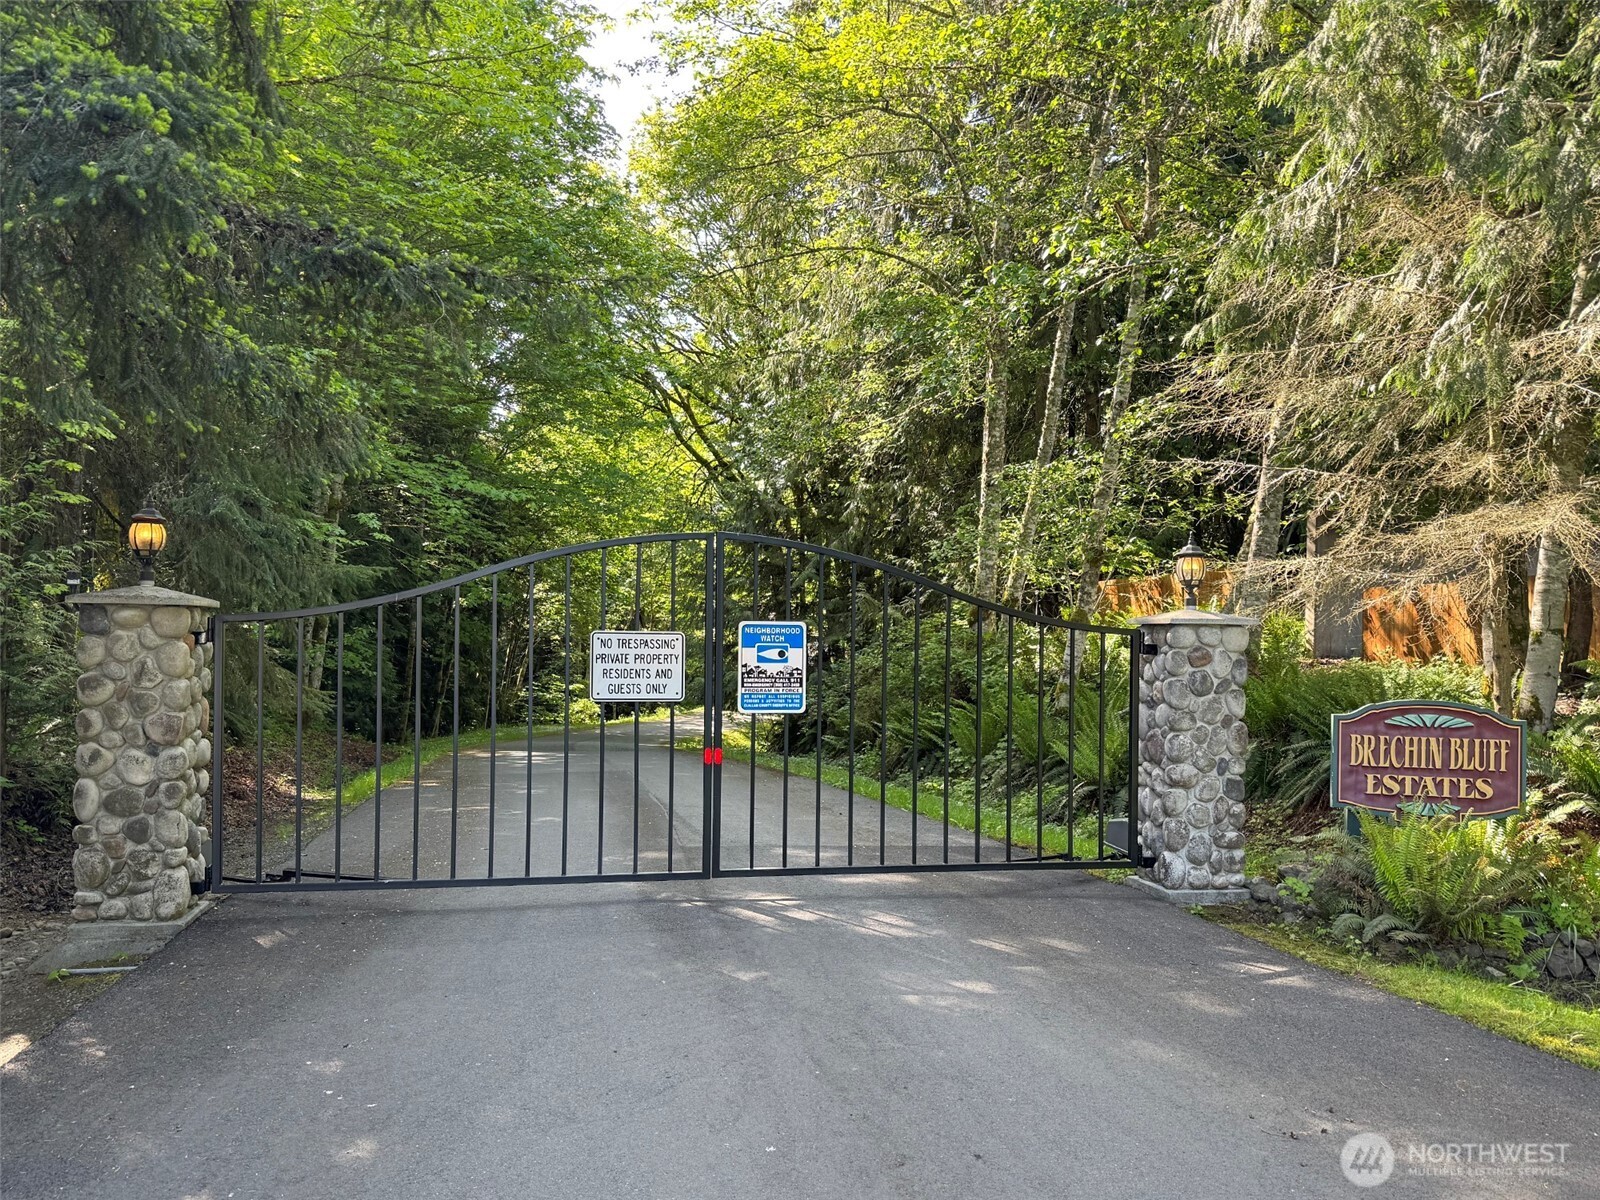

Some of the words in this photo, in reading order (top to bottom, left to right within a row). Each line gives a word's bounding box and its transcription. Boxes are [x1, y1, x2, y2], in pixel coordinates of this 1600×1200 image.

[600, 638, 612, 649] NO
[617, 638, 676, 650] TRESPASSING
[596, 654, 630, 664] PRIVATE
[634, 654, 680, 664] PROPERTY
[602, 668, 651, 680] RESIDENTS
[655, 668, 672, 680] AND
[608, 684, 642, 694] GUESTS
[646, 684, 668, 694] ONLY
[1349, 734, 1444, 770] BRECHIN
[1448, 737, 1511, 772] BLUFF
[1364, 773, 1494, 800] ESTATES
